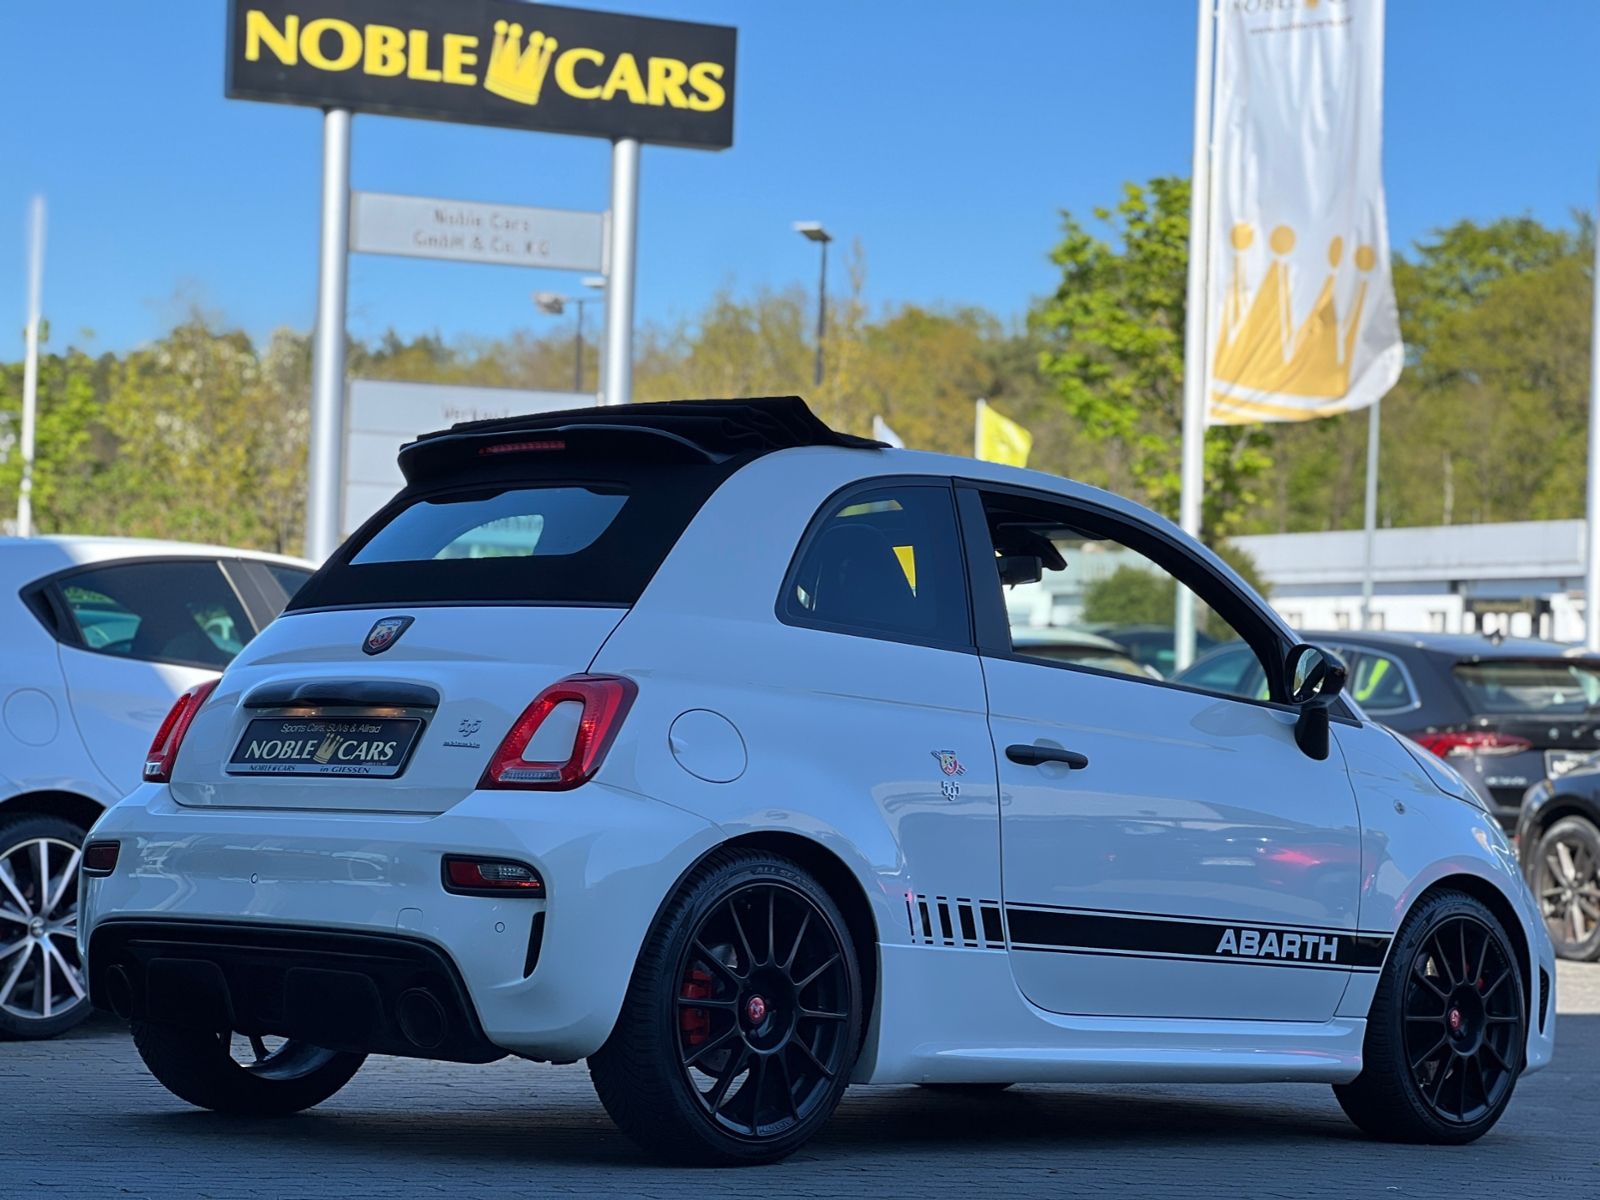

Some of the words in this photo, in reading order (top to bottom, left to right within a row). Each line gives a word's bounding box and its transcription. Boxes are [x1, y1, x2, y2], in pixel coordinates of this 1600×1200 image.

[245, 10, 479, 86] NOBLE
[554, 47, 726, 112] CARS
[281, 723, 307, 734] Sports
[349, 724, 356, 733] &
[244, 739, 318, 761] NOBLE
[337, 740, 397, 762] CARS
[319, 765, 329, 773] in
[331, 765, 371, 774] GIESSEN
[1216, 928, 1339, 962] ABARTH
